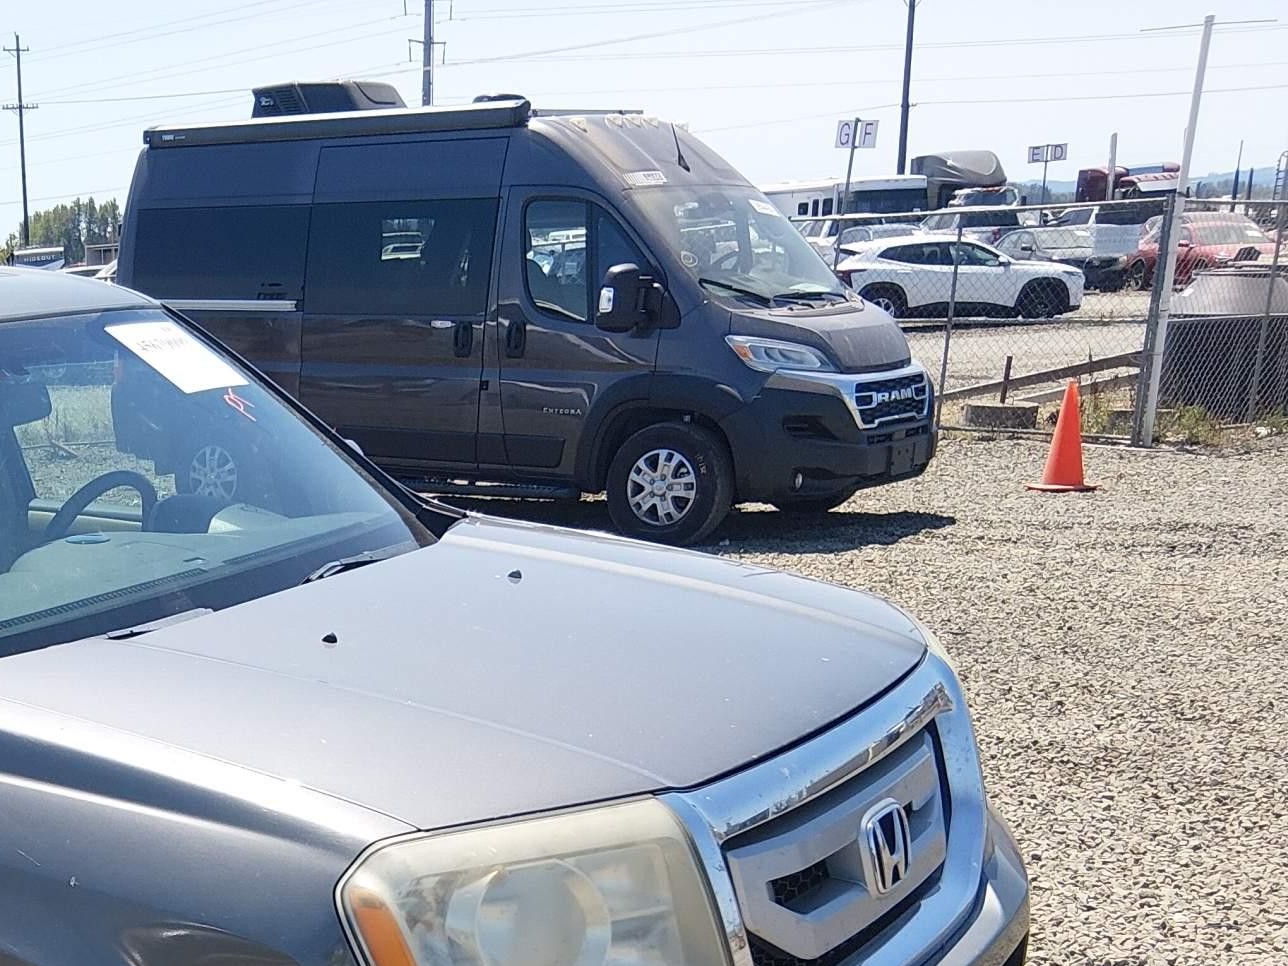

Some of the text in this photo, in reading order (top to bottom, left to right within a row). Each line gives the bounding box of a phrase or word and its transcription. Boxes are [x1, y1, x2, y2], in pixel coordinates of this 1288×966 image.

[839, 122, 851, 146] G
[862, 122, 874, 146] F
[1031, 147, 1041, 161] E
[1053, 145, 1064, 160] D
[23, 255, 56, 263] HIDEOUT
[877, 387, 913, 403] RAM
